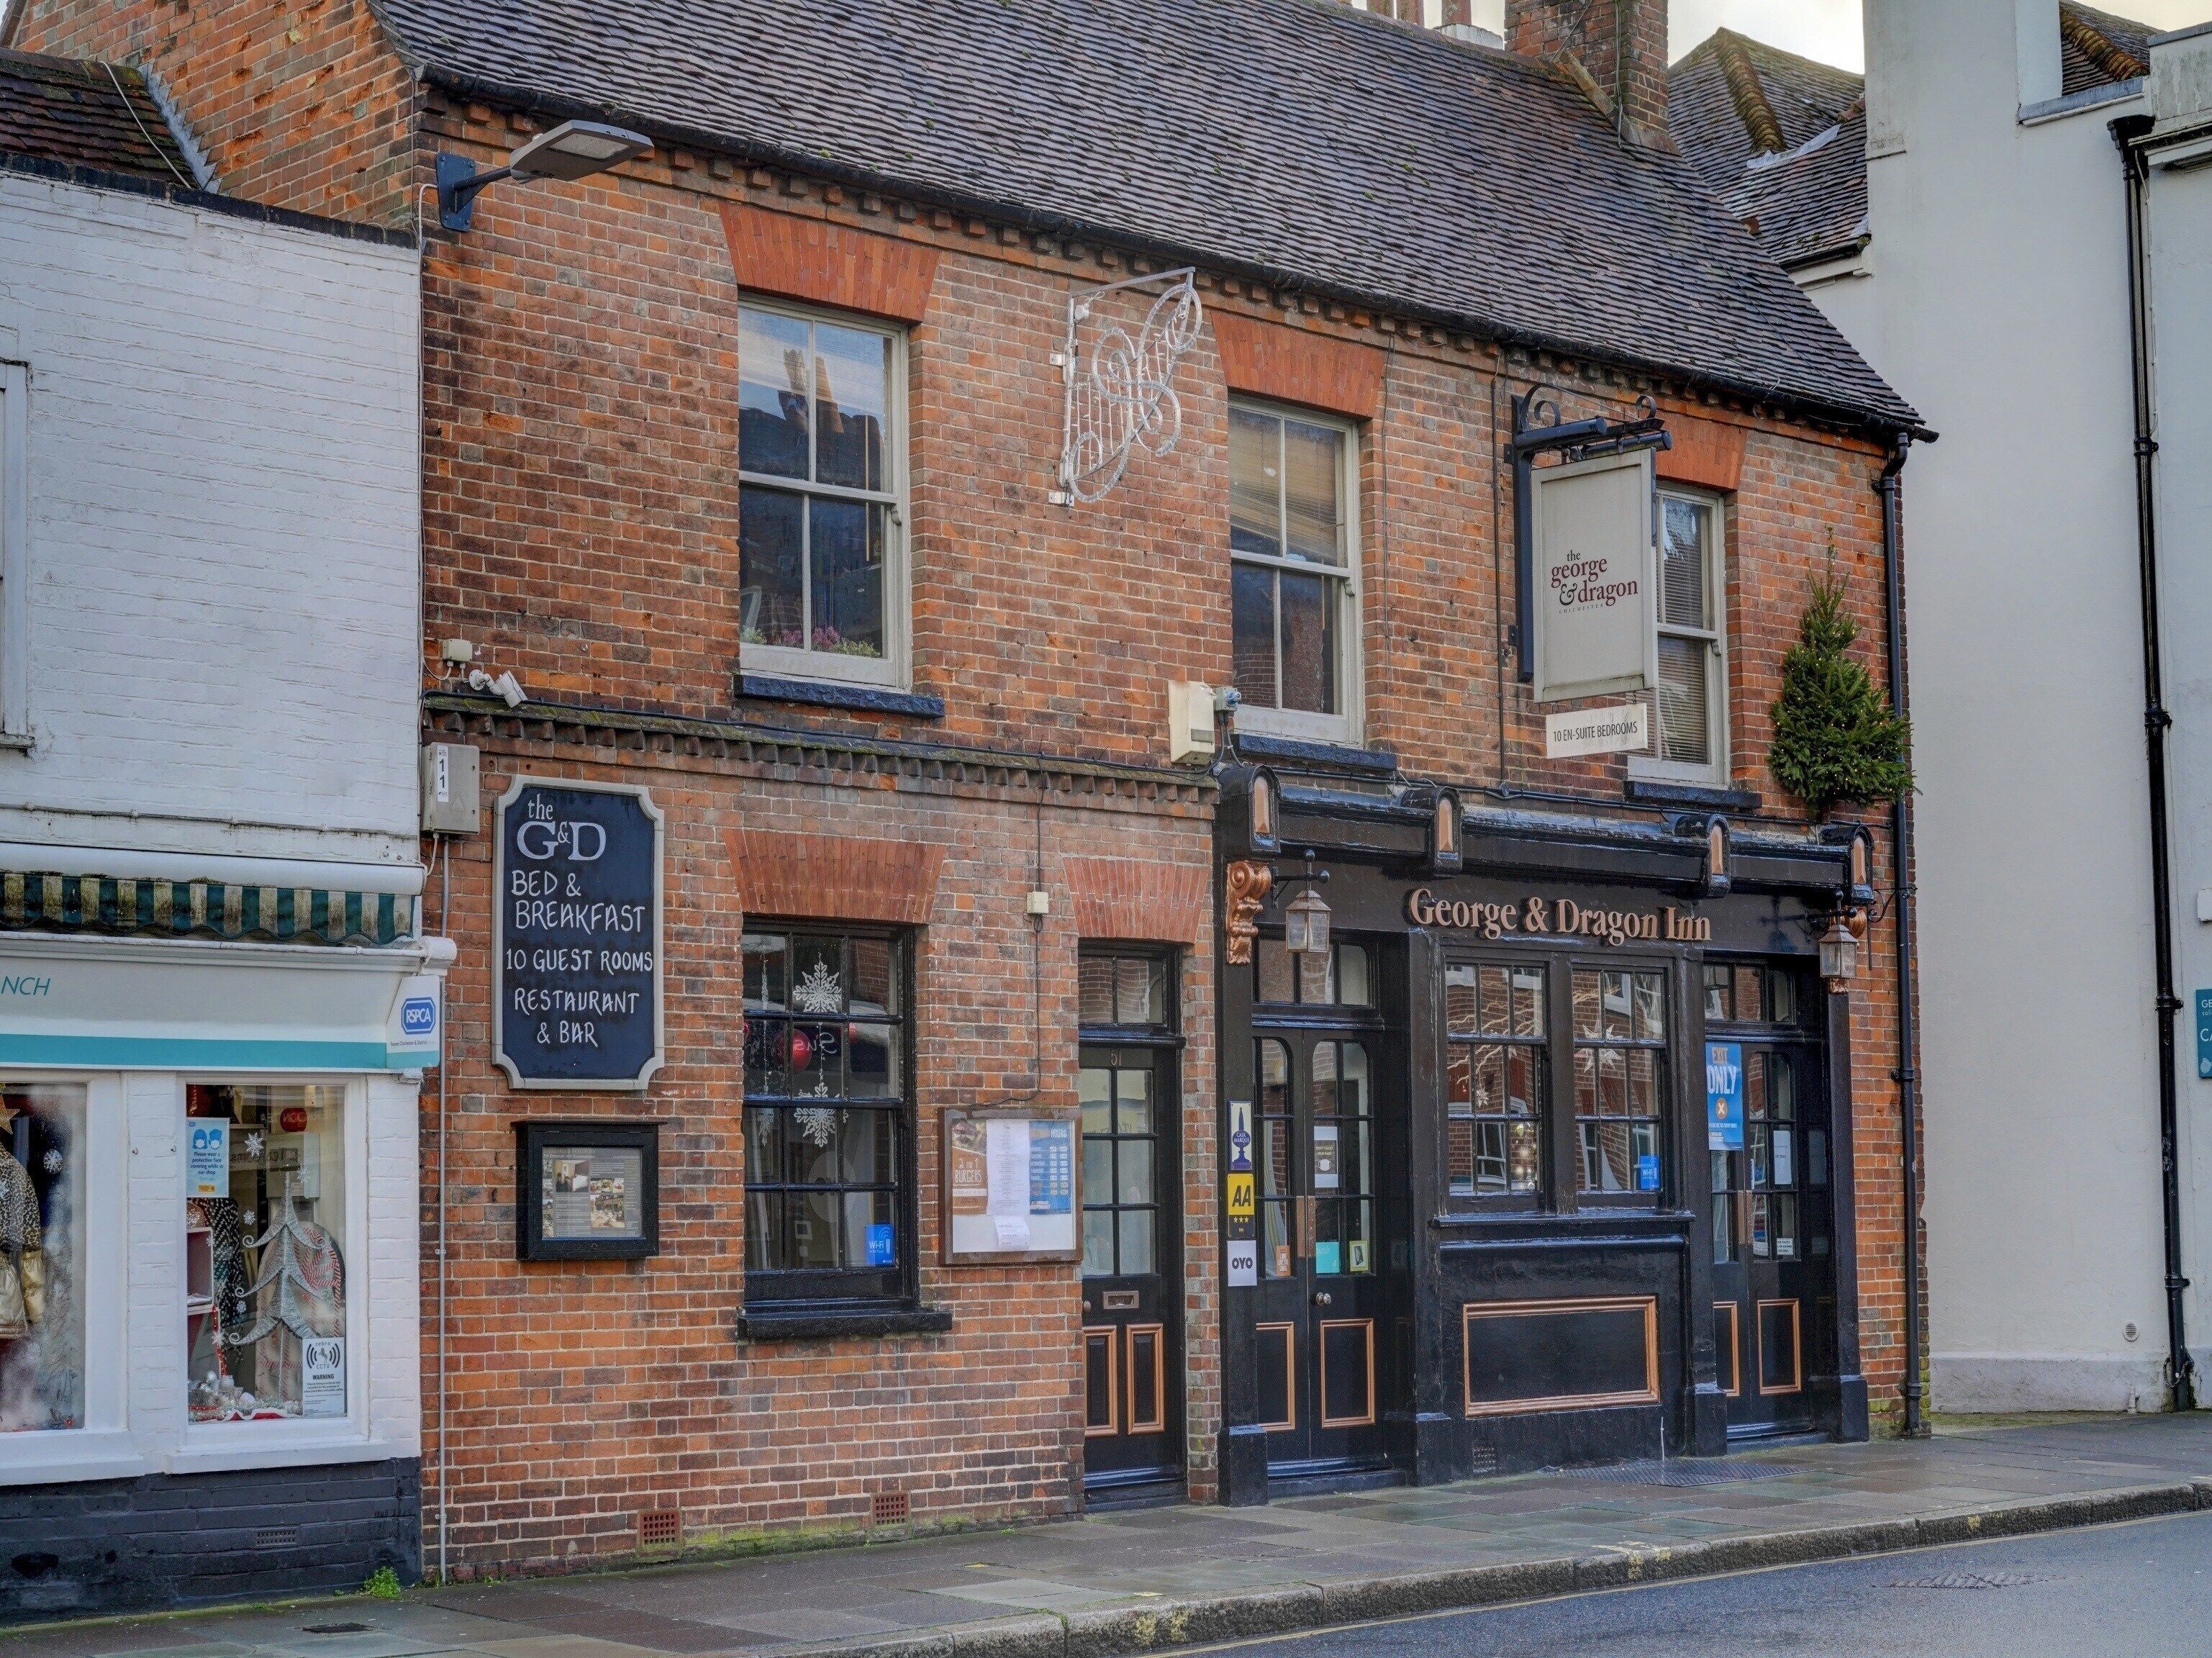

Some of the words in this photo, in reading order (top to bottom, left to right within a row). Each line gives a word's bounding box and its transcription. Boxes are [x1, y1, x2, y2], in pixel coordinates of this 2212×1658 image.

[1567, 550, 1581, 561] the
[1551, 558, 1608, 589] george
[1559, 583, 1577, 605] &
[1577, 579, 1638, 607] dragon
[1553, 730, 1561, 742] 10
[1563, 725, 1595, 740] EN-SUITE
[1597, 721, 1638, 738] BEDROOMS
[527, 793, 553, 820] the
[511, 869, 558, 897] BED
[566, 872, 581, 897] &
[515, 900, 645, 936] BREAKFAST
[1409, 887, 1518, 940] George
[1525, 897, 1549, 933] &
[1556, 898, 1658, 946] Dragon
[1666, 907, 1712, 941] Inn
[506, 948, 527, 970] 10
[532, 948, 593, 972] GUEST
[600, 950, 653, 975] ROOMS
[515, 987, 640, 1016] RESTAURANT
[406, 1007, 432, 1023] RSPCA
[536, 1021, 550, 1044] &
[559, 1020, 598, 1048] BAR
[2200, 1028, 2212, 1042] C
[1712, 1047, 1728, 1064] EXIT
[1706, 1064, 1737, 1095] ONLY
[955, 1169, 982, 1183] BURGERS
[958, 1158, 964, 1169] 2
[1231, 1184, 1251, 1207] AA
[869, 1241, 884, 1249] Wi-Fi
[1231, 1256, 1253, 1269] OYO
